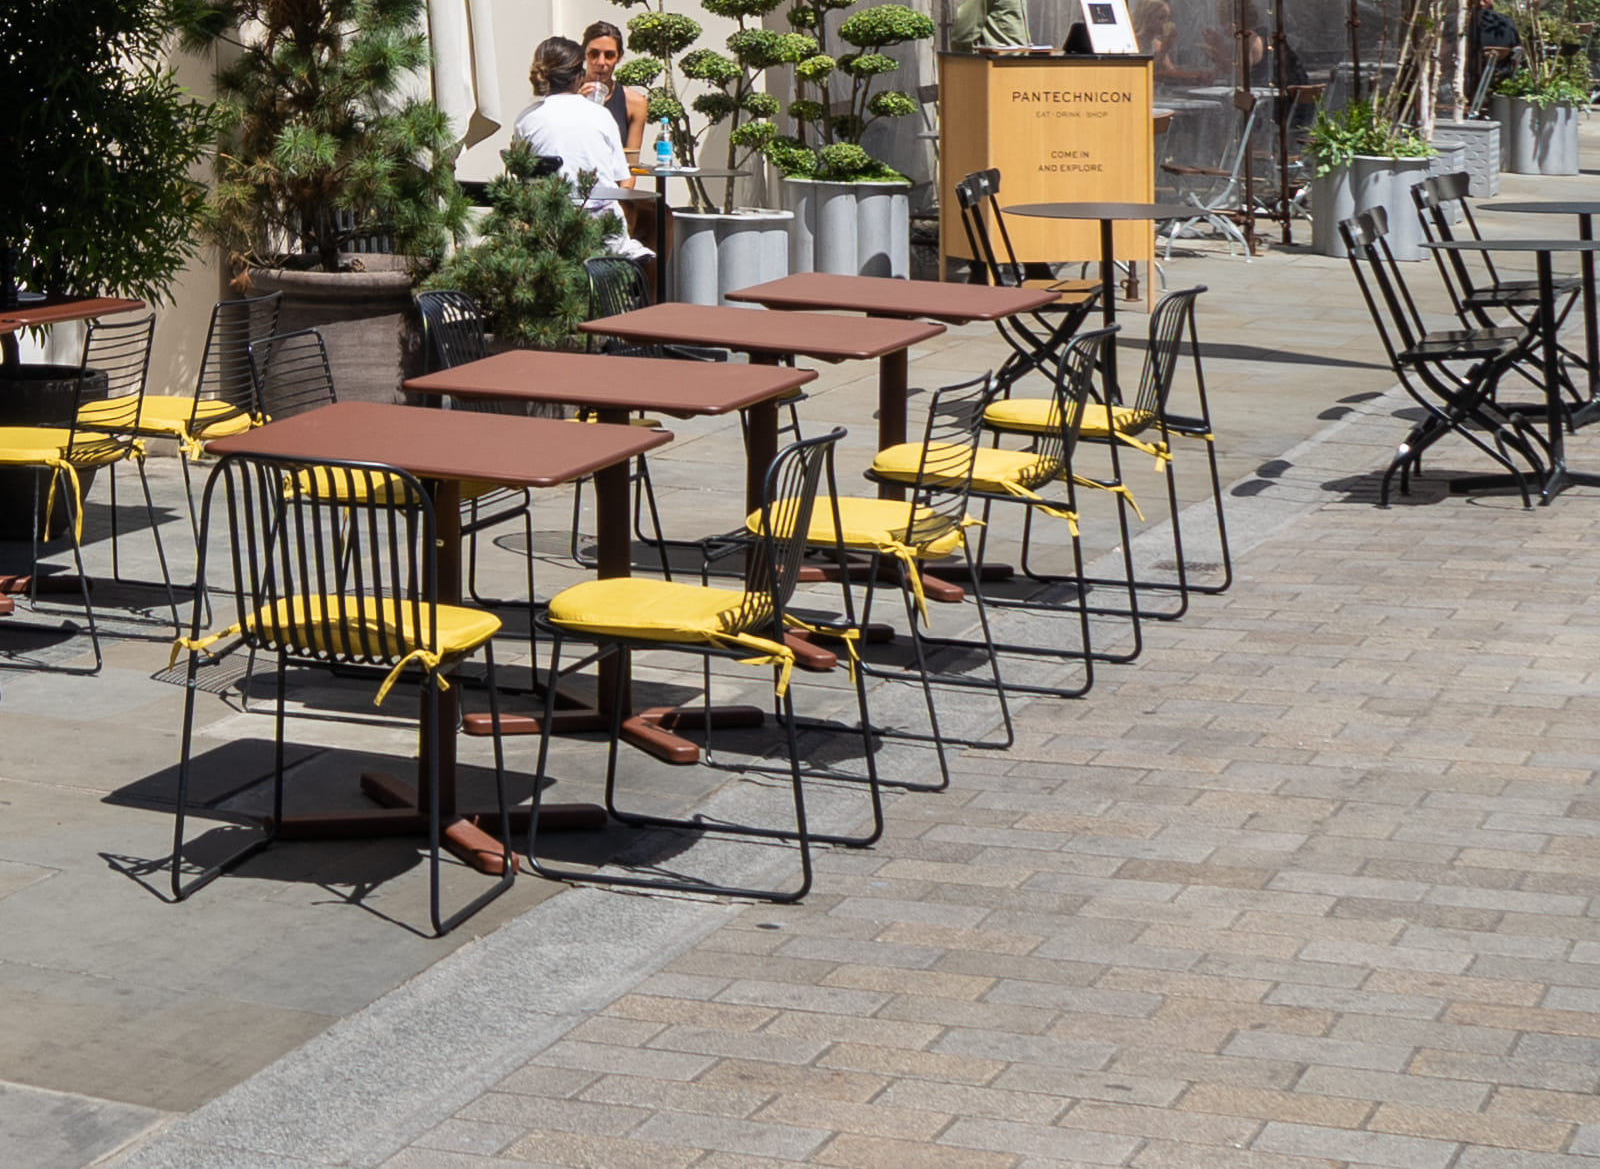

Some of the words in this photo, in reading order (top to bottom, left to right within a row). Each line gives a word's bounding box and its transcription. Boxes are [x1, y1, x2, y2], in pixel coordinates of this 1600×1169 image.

[1011, 91, 1132, 103] PANTECHNICON
[1050, 150, 1078, 159] COME
[1080, 150, 1090, 159] IN
[1038, 164, 1058, 172] AND
[1060, 164, 1104, 172] EXPLORE
